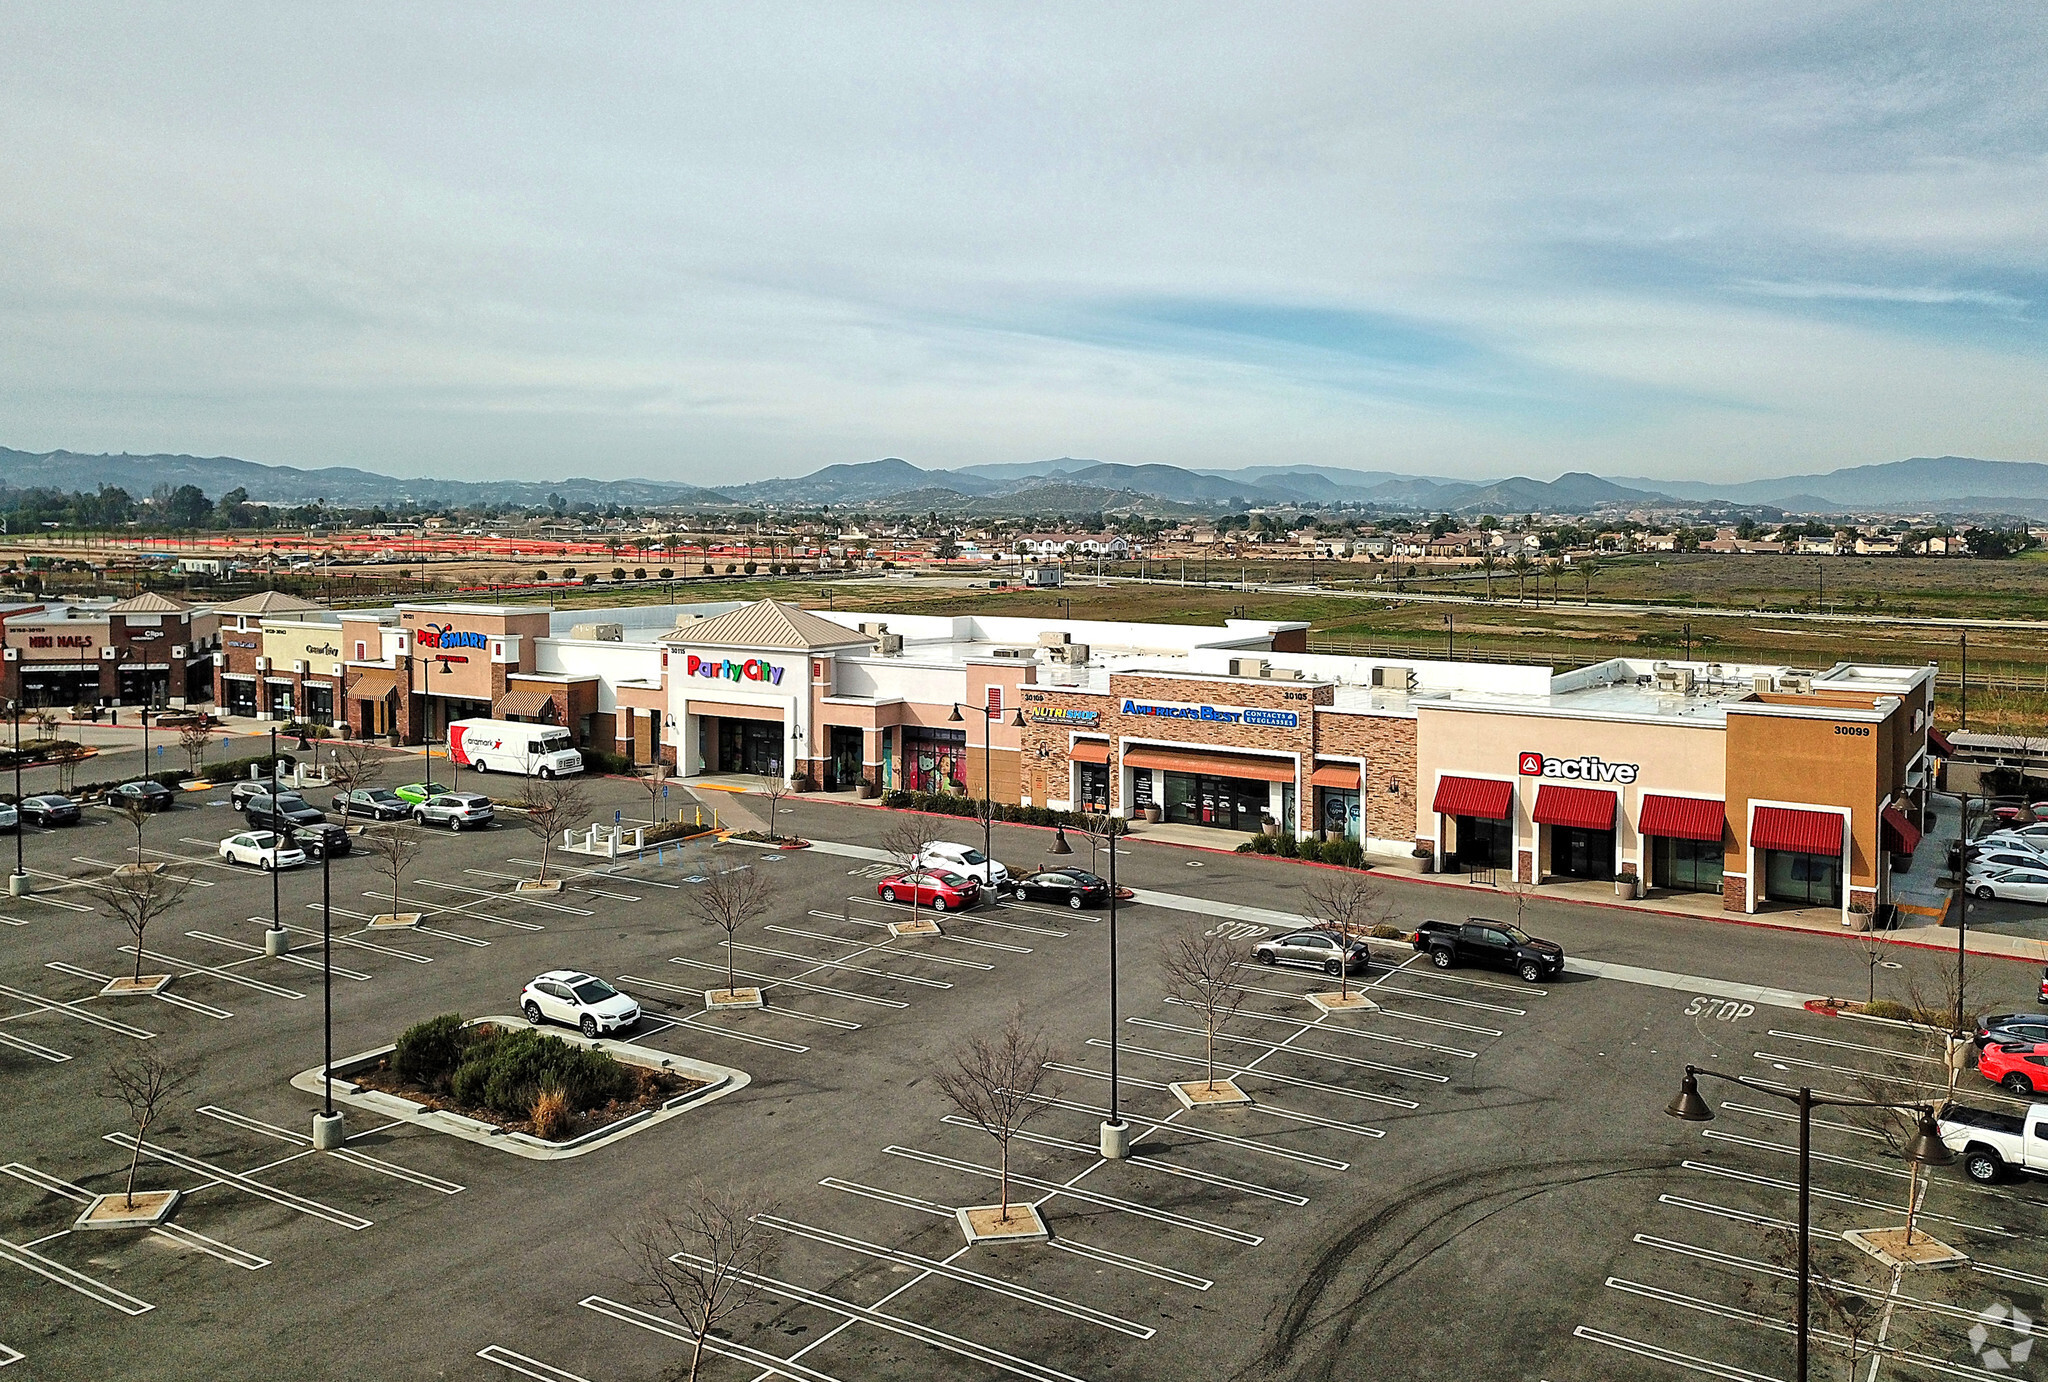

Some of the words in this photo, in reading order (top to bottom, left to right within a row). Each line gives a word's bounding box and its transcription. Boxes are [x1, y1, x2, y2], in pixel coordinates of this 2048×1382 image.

[144, 630, 164, 638] Clips
[417, 629, 488, 650] PETSMART
[29, 636, 52, 648] NIKI
[1284, 692, 1307, 700] 30105
[1032, 706, 1098, 720] NUTRISHOP
[1200, 706, 1242, 722] BEST
[1245, 711, 1286, 719] CONTACTS
[1246, 716, 1293, 726] EYEGLASSES
[1834, 726, 1870, 736] 30099
[468, 738, 493, 746] aramark
[1542, 757, 1637, 784] active
[1205, 921, 1270, 941] STOP
[1684, 996, 1755, 1022] STOP
